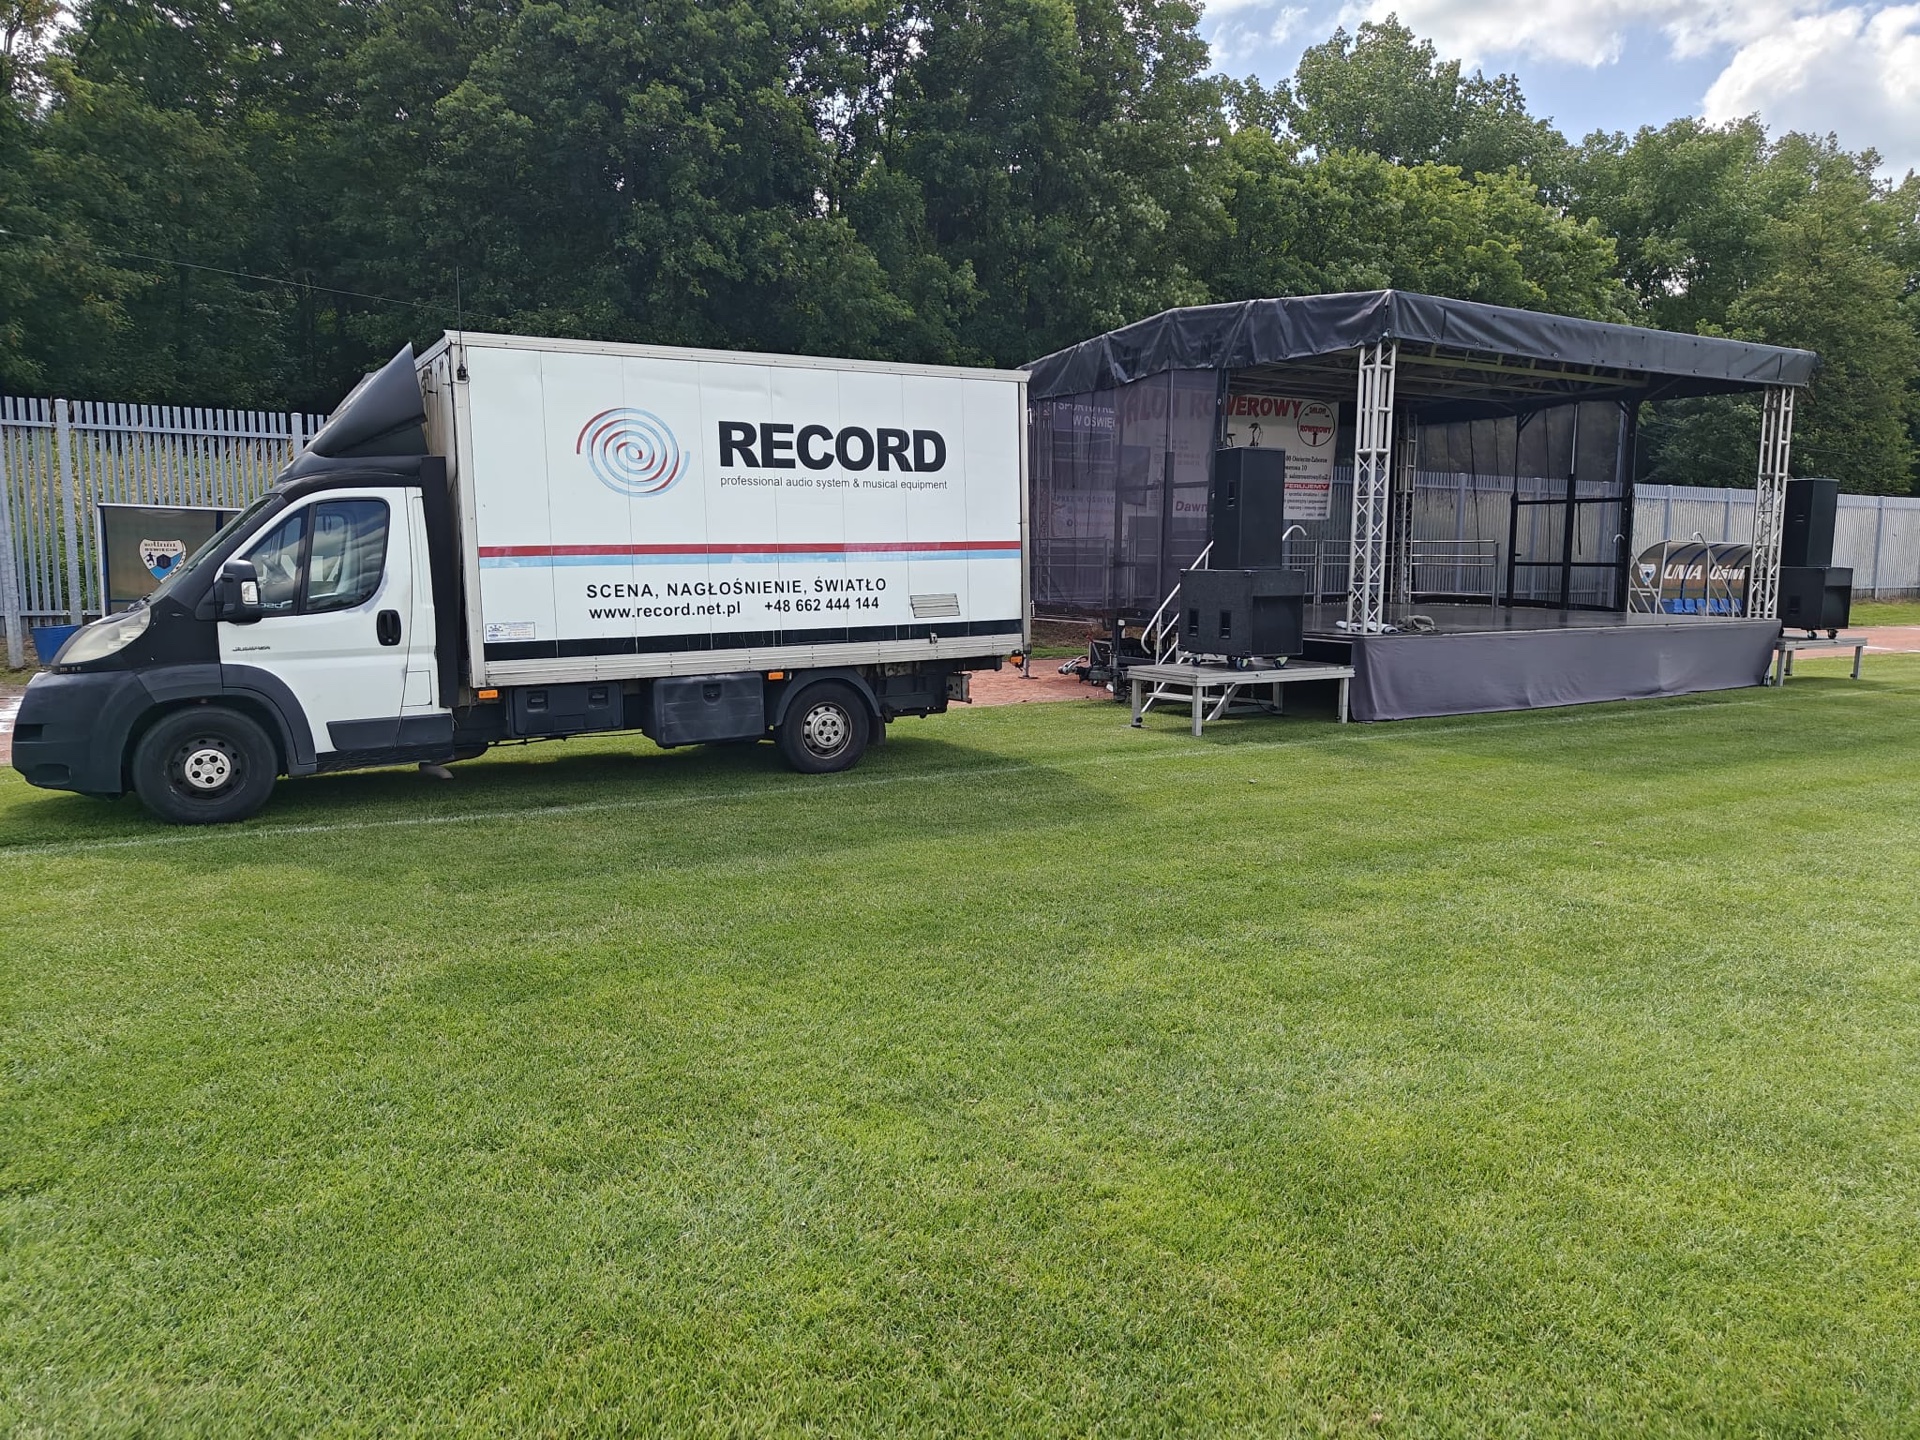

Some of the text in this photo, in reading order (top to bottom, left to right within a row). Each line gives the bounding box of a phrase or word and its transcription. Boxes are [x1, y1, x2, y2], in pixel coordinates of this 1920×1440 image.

[718, 420, 947, 473] RECORD
[720, 475, 948, 491] professional audio system & musical equipment
[1663, 564, 1703, 580] UNIA
[586, 576, 887, 600] SCENA, NAGŁOŚNIENIE, ŚWIATŁO
[588, 597, 880, 619] www.record.net.pl +48 662 444 144
